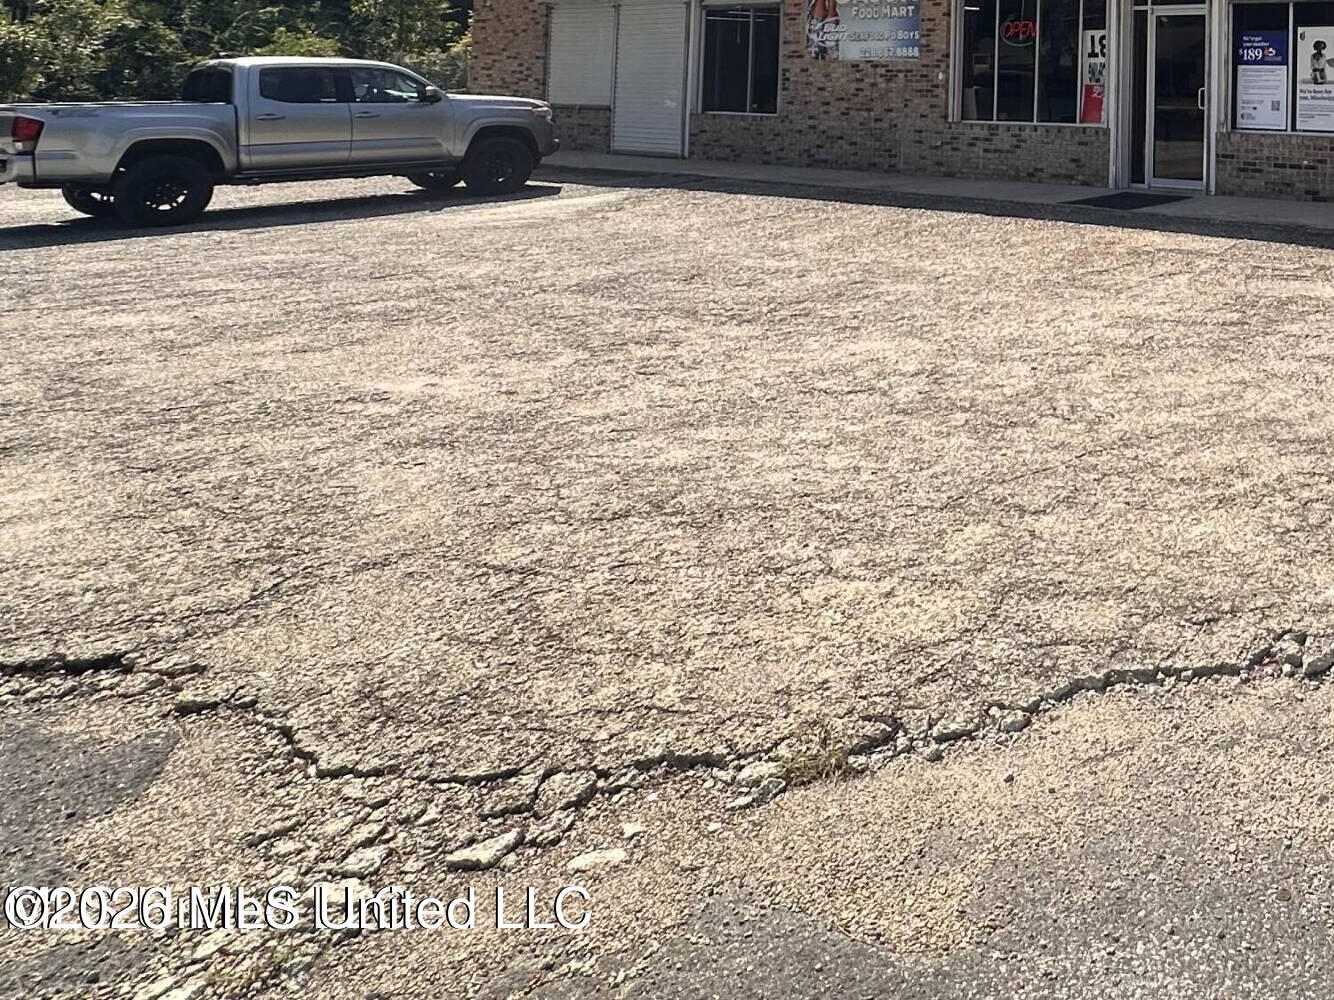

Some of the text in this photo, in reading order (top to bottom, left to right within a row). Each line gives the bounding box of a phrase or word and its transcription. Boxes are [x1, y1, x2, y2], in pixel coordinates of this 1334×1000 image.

[851, 5, 915, 18] FOOD MART
[823, 23, 847, 32] BUD
[1003, 20, 1037, 39] OPEN
